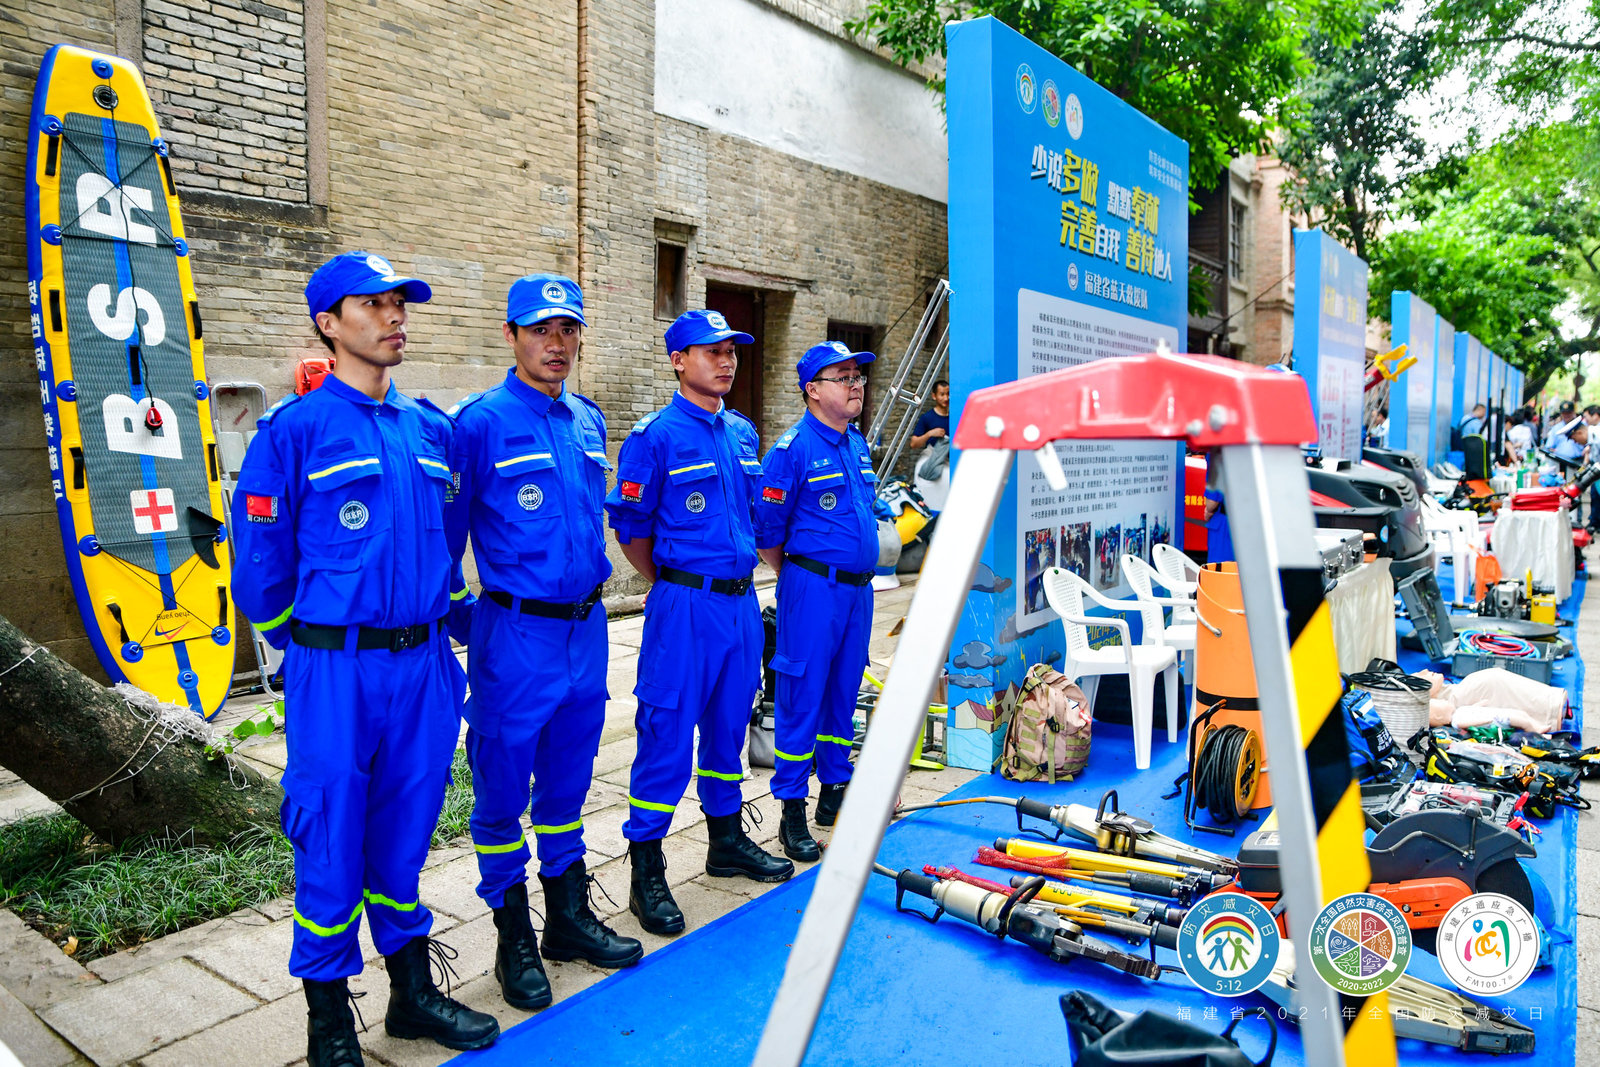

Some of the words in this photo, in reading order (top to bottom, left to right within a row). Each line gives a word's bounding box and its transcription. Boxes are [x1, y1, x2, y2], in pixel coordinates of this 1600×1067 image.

[1031, 144, 1099, 208] 少说多做
[1107, 180, 1159, 236] 默默奉献
[1060, 200, 1120, 262] 完善自我
[1126, 227, 1172, 281] 善待他人
[1084, 270, 1148, 310] 福建省蓝天救援队
